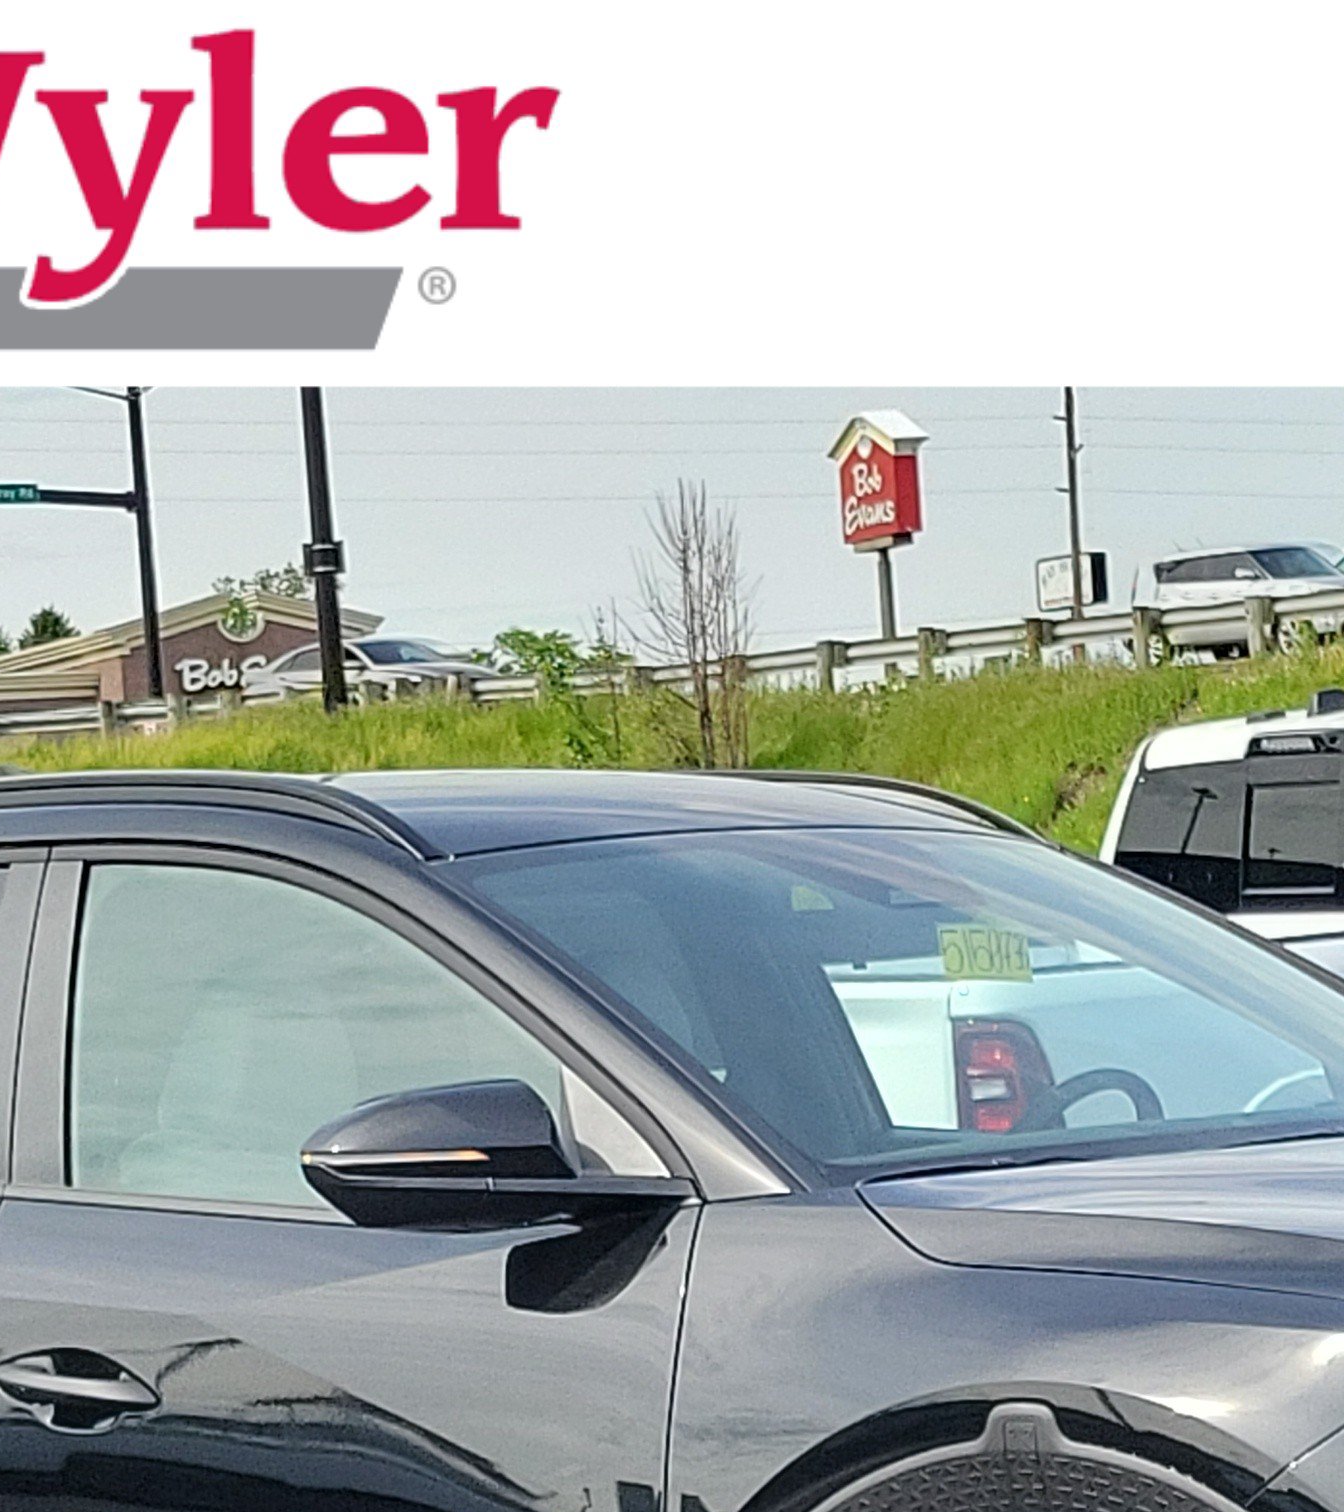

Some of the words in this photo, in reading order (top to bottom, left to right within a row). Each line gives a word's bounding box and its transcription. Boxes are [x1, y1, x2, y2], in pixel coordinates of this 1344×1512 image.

[851, 462, 883, 498] Bob
[844, 495, 896, 536] Evans
[174, 658, 239, 692] Bob
